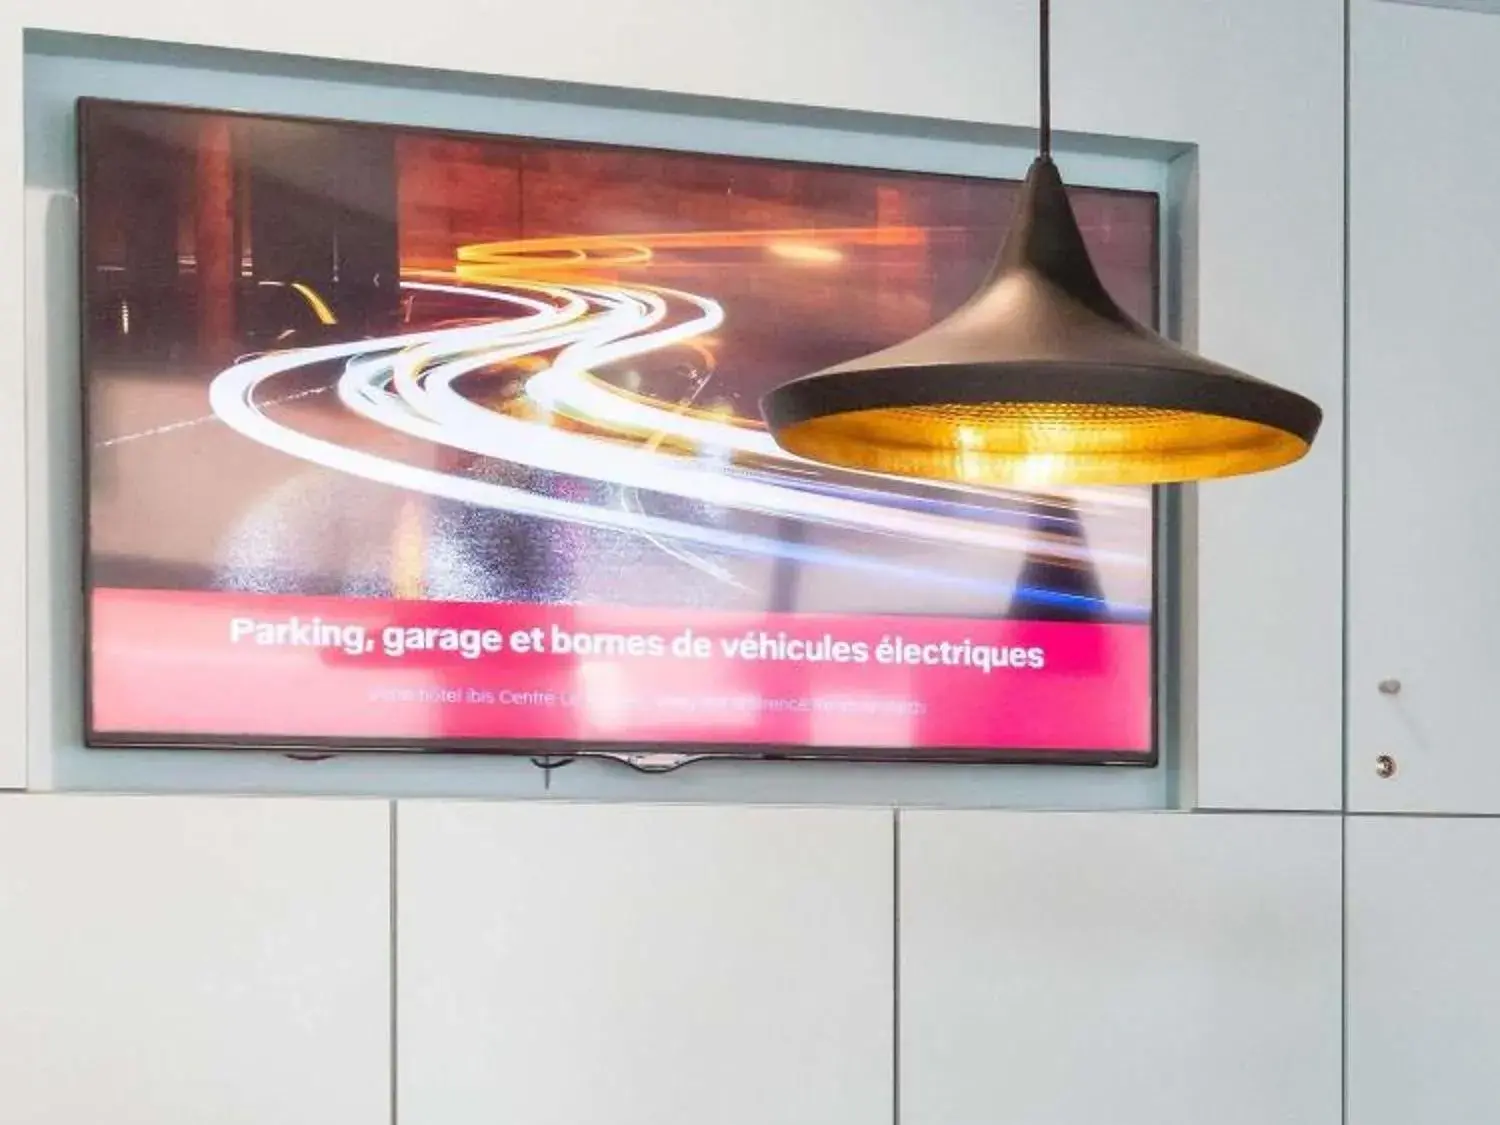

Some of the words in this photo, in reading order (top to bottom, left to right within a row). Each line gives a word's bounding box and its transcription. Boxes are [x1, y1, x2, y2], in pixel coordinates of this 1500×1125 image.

[229, 617, 374, 655] Parking,
[381, 625, 503, 659] garage
[509, 627, 545, 653] et
[551, 623, 664, 657] bornes
[671, 627, 712, 658] de
[721, 630, 869, 662] véhicules
[875, 634, 1045, 673] électriques
